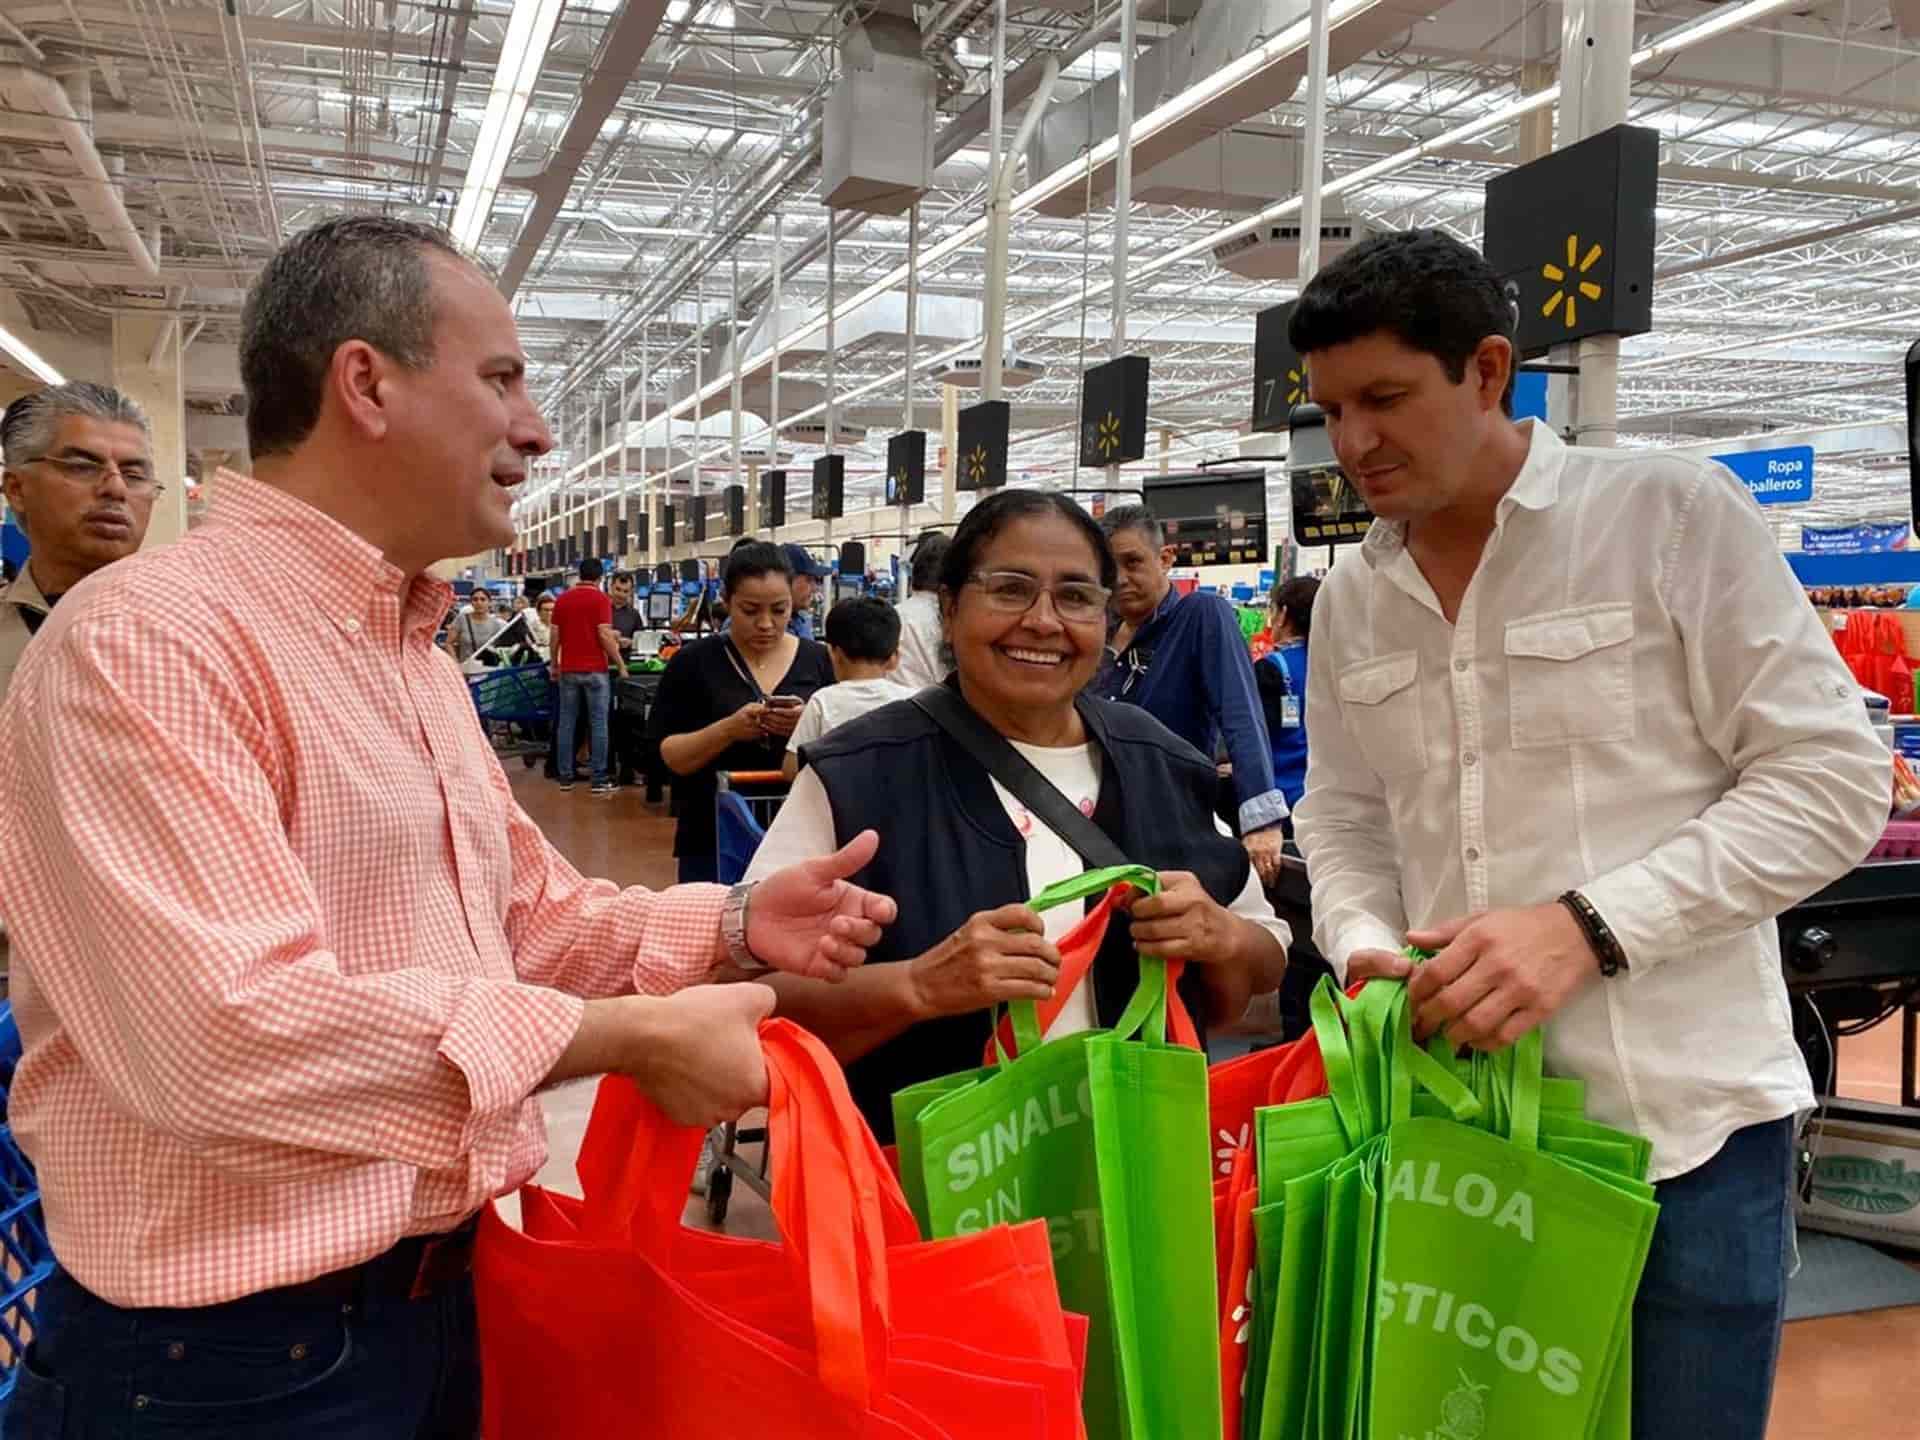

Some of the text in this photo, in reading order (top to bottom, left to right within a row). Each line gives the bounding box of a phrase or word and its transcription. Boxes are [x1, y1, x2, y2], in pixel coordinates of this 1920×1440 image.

[1263, 379, 1276, 417] 7
[1768, 460, 1803, 476] Ropa
[1747, 478, 1802, 493] balleros
